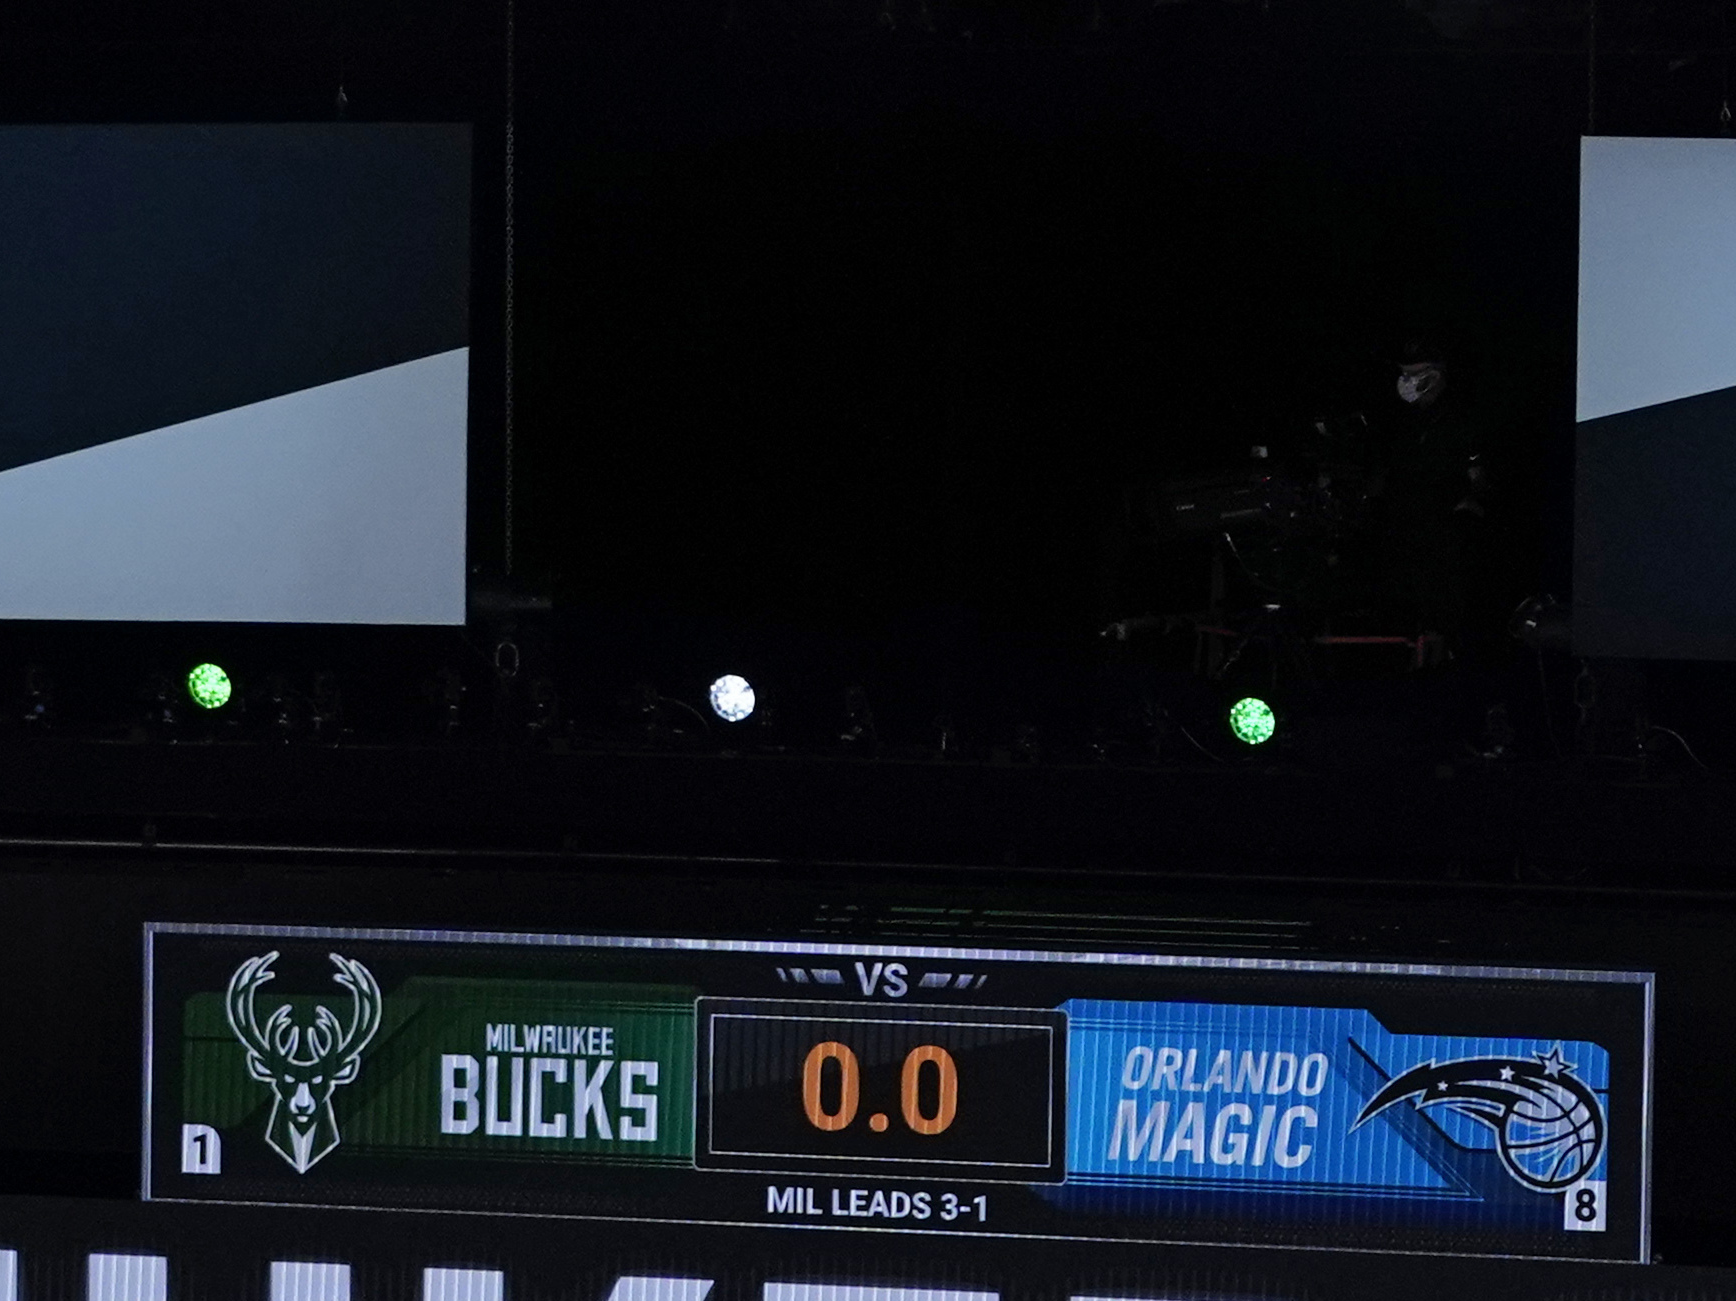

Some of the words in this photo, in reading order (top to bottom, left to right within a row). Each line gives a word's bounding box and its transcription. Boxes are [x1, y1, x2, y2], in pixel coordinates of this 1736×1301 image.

[854, 962, 909, 997] VS
[486, 1023, 614, 1056] MILWAUKEE
[803, 1041, 958, 1135] 0.0
[1122, 1045, 1328, 1097] ORLANDO
[441, 1054, 659, 1142] BUCKS
[193, 1133, 207, 1165] 1
[1108, 1099, 1318, 1168] MAGIC
[767, 1186, 823, 1215] MIL
[832, 1188, 932, 1220] LEADS
[940, 1193, 987, 1222] 3-1
[1574, 1188, 1596, 1223] 8
